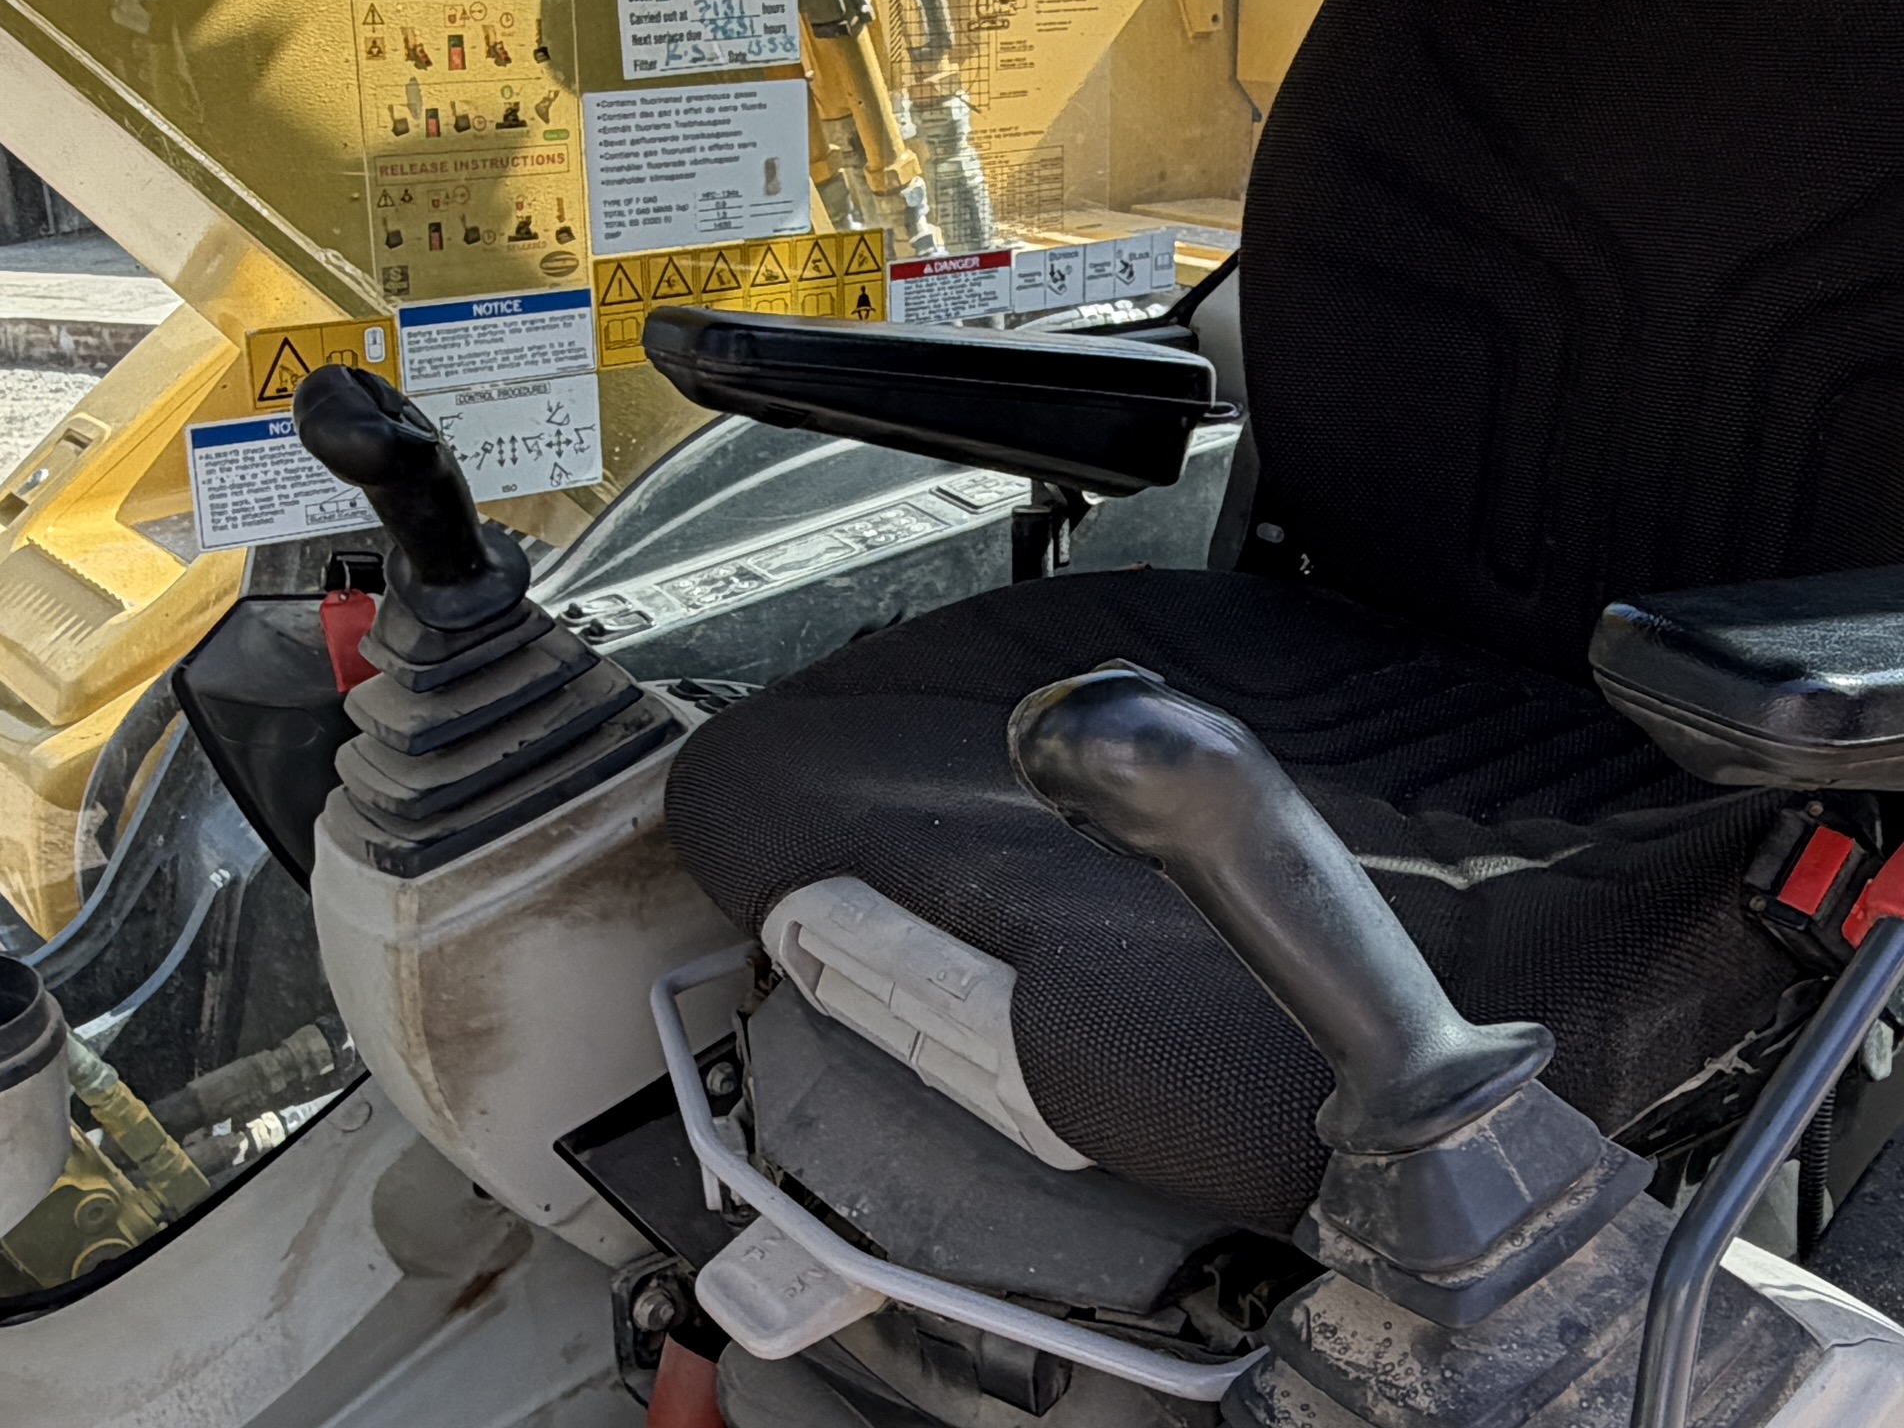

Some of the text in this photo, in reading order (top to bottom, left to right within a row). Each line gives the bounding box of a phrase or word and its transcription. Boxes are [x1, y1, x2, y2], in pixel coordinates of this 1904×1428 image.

[762, 3, 785, 14] hours
[630, 11, 688, 25] Carried out at
[764, 23, 787, 35] hours
[632, 30, 701, 46] Next service due
[728, 51, 747, 64] Date
[633, 60, 657, 72] Fitter
[379, 153, 565, 178] RELEASE INSTRUCTIONS
[603, 199, 622, 208] TYPE
[604, 209, 626, 219] TOTAL
[935, 256, 980, 272] DANGER
[472, 299, 522, 317] NOTICE
[407, 329, 433, 340] Before
[521, 317, 546, 327] engine
[525, 323, 560, 334] operation
[418, 354, 444, 365] engine
[458, 384, 547, 403] CONTROL PROCEDURES
[502, 484, 518, 493] ISO
